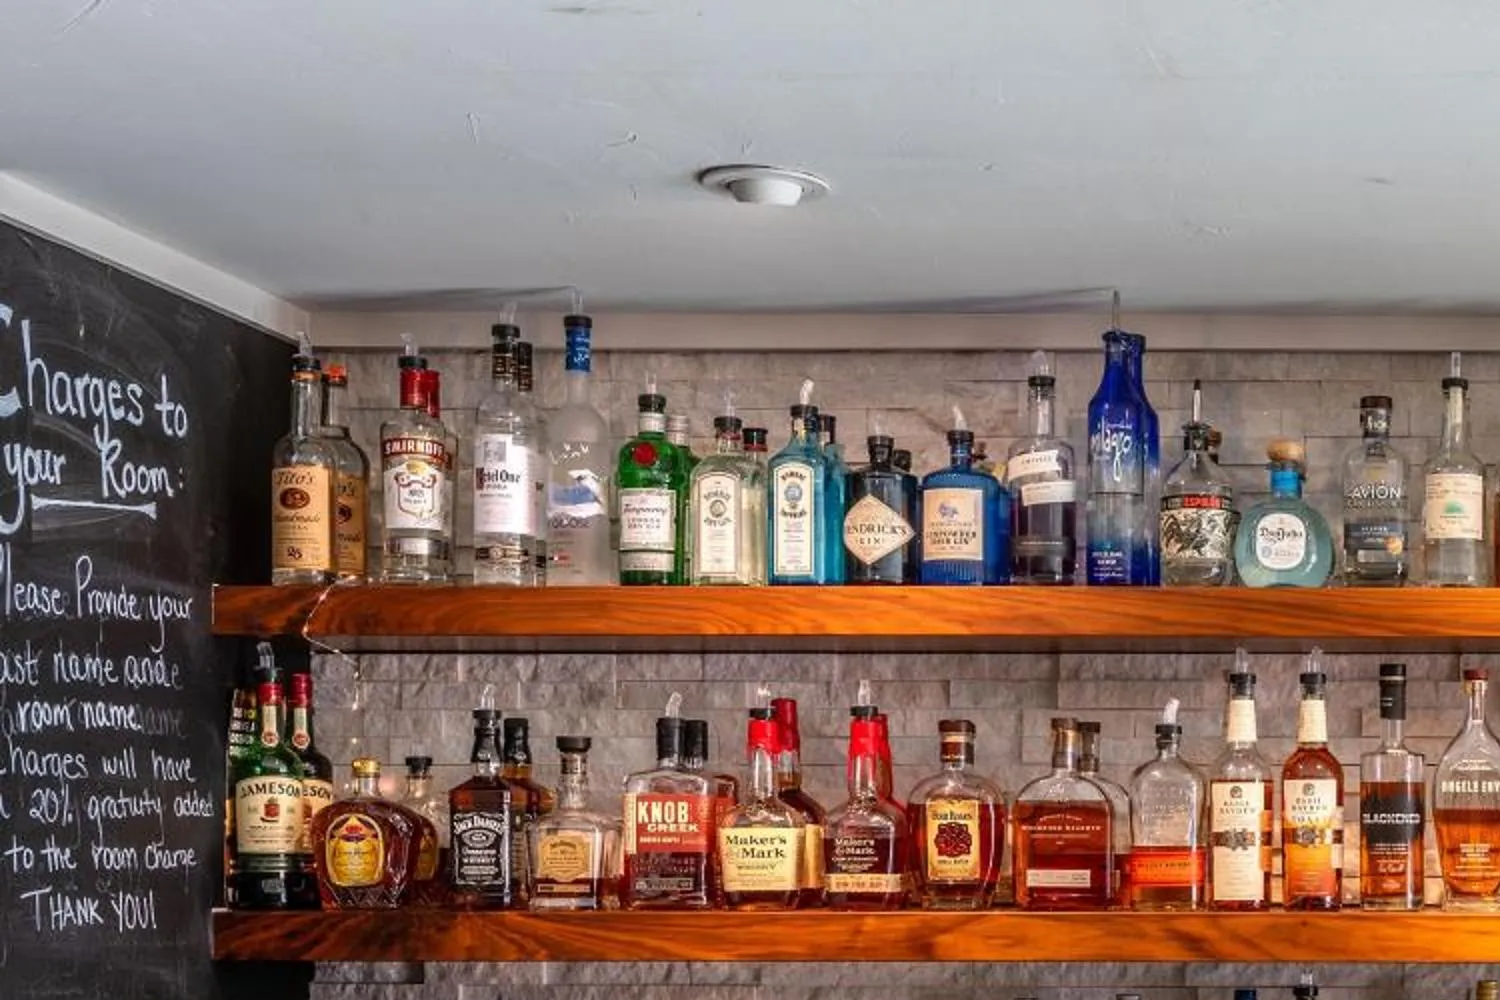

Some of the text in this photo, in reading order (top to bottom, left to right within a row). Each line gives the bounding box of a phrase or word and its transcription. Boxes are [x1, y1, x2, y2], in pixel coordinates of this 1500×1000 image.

[155, 373, 187, 438] to
[0, 442, 67, 535] your
[0, 542, 193, 653] lease Provide your
[18, 697, 74, 732] room
[102, 746, 137, 780] will
[152, 749, 198, 784] have
[29, 784, 74, 828] 20%
[173, 790, 215, 818] added
[637, 800, 690, 824] KNOB
[3, 834, 35, 873] to
[41, 833, 77, 873] the
[91, 841, 139, 871] room
[726, 835, 788, 846] Maker's
[741, 846, 786, 860] Mark
[20, 885, 104, 932] THANK
